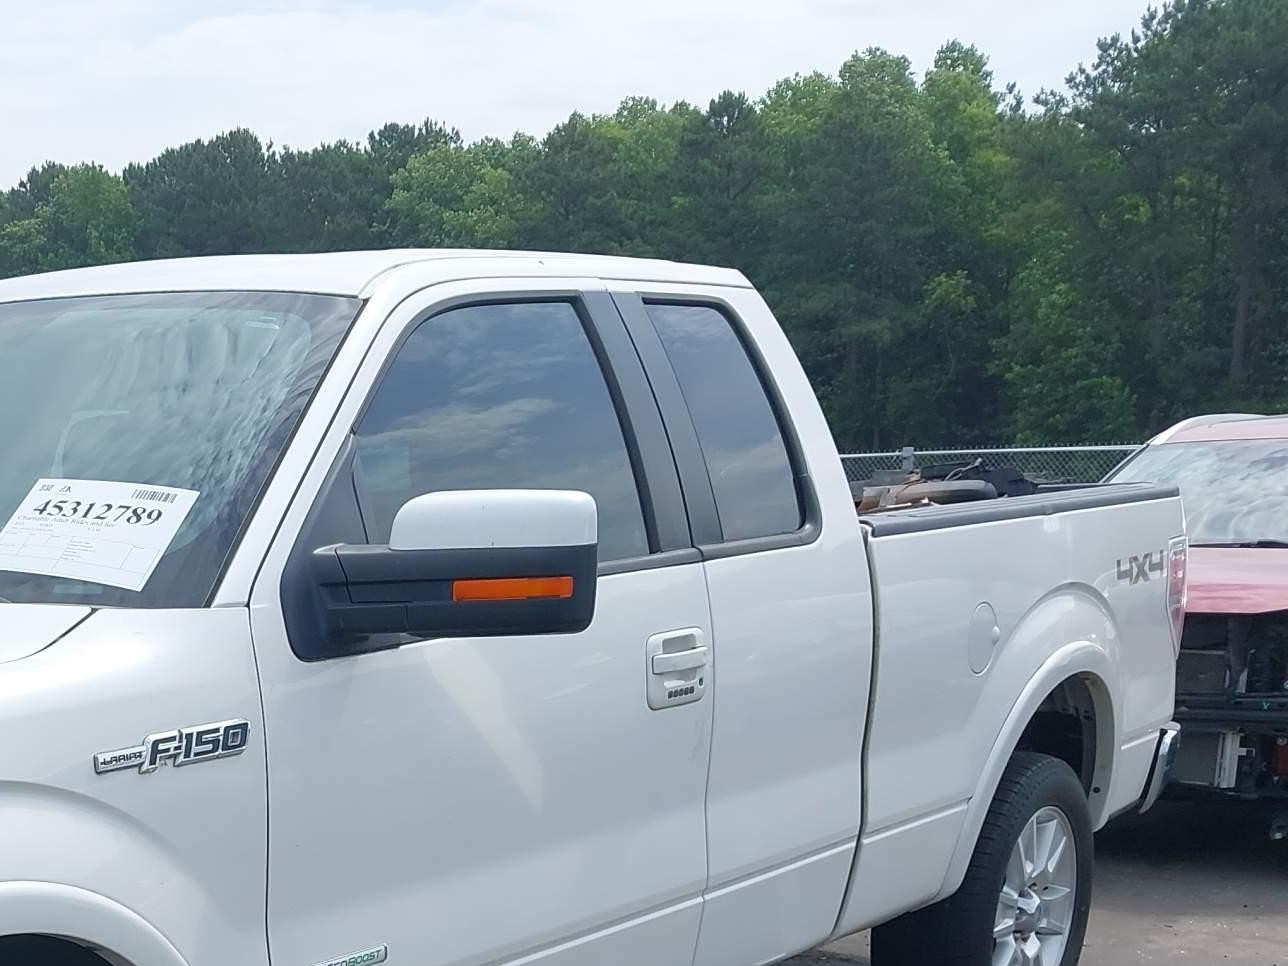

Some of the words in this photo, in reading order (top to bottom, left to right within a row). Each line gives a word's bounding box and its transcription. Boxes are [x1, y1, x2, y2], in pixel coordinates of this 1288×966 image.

[33, 498, 163, 526] 45312789
[100, 749, 145, 766] LARIAT
[147, 720, 250, 768] F-150
